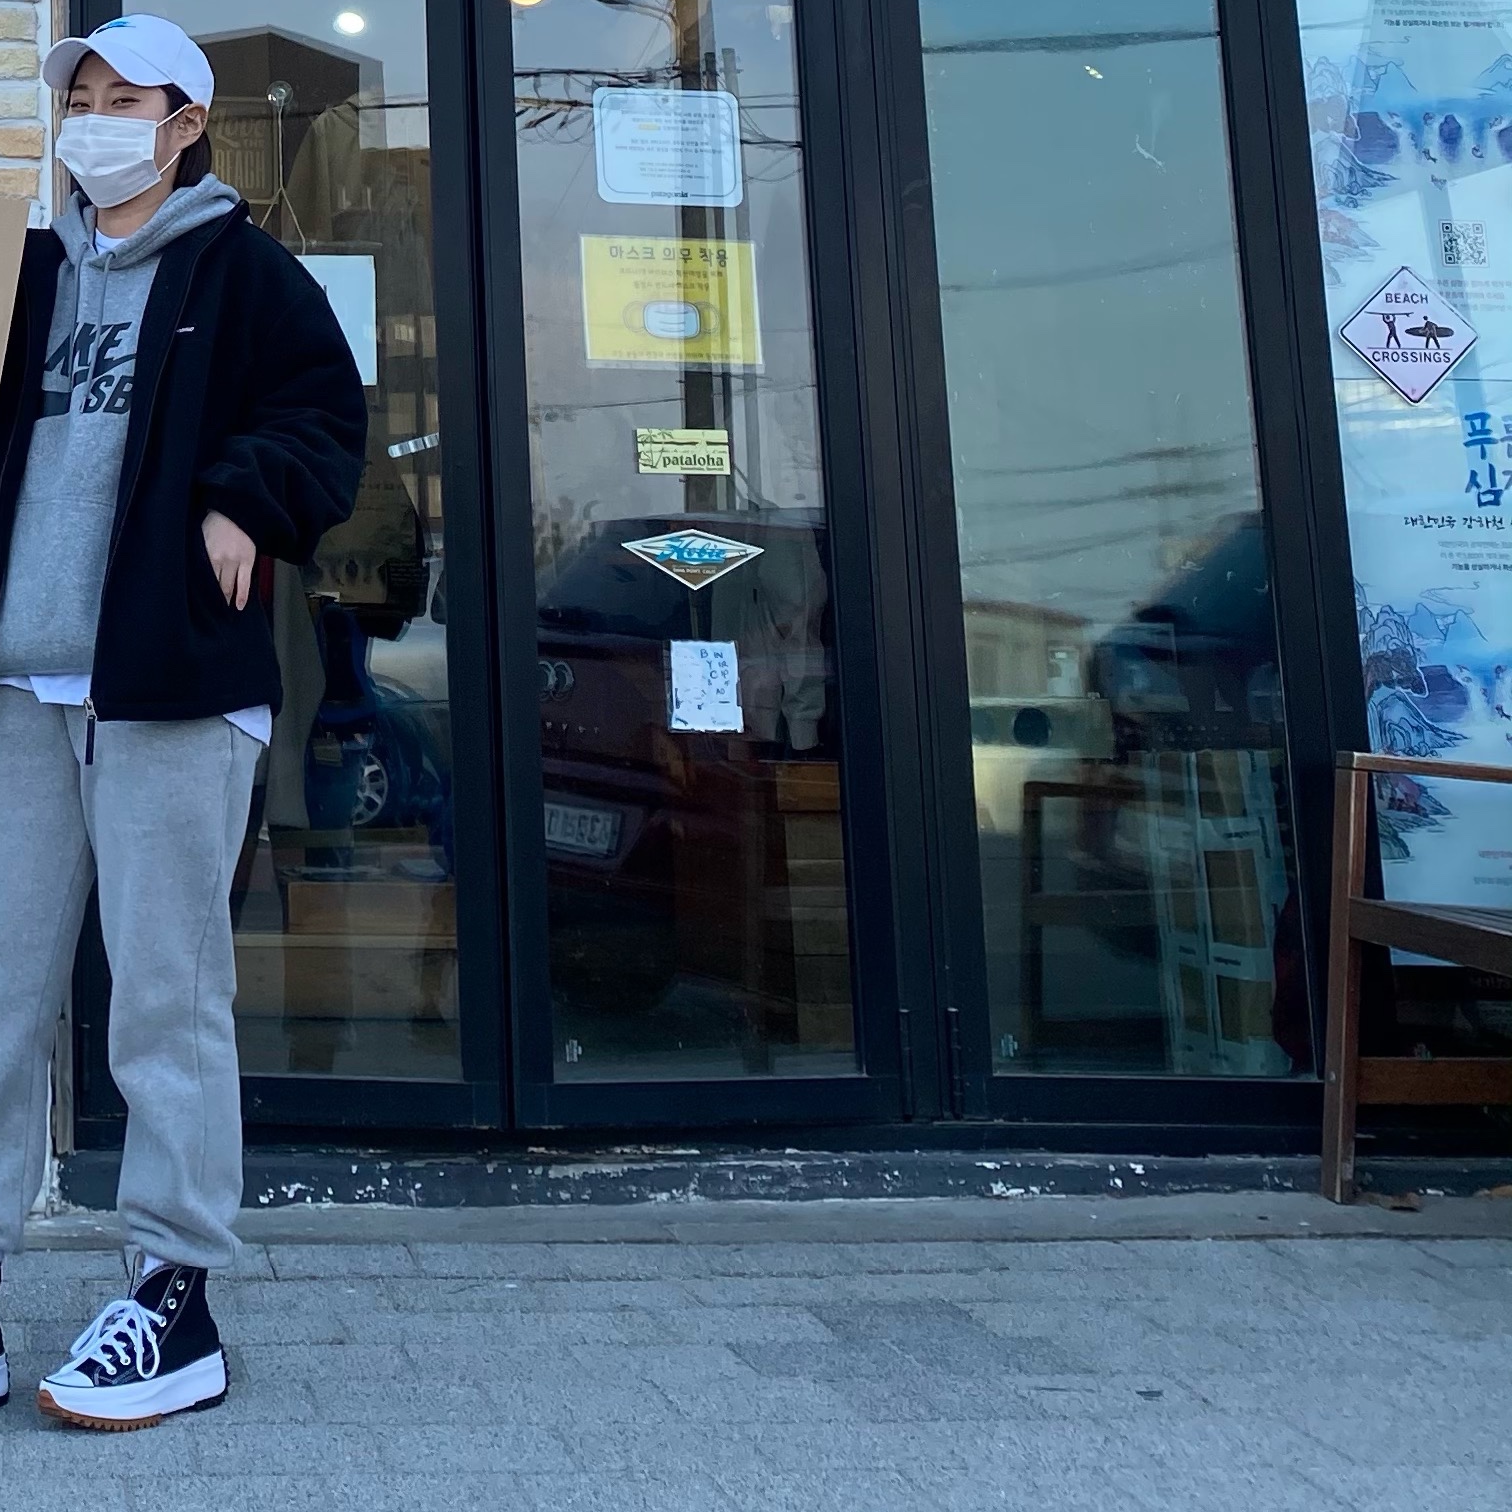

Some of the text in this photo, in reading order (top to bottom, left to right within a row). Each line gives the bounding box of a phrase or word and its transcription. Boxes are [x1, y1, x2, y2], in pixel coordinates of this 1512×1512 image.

[609, 245, 729, 268] 마스크 의무 착용
[1385, 292, 1429, 305] BEACH
[44, 321, 133, 377] NKE
[1371, 350, 1452, 364] CROSSINGS
[82, 374, 135, 414] SB
[662, 453, 724, 469] pataloha
[1464, 462, 1512, 508] 심
[1403, 514, 1457, 529] 대한민국
